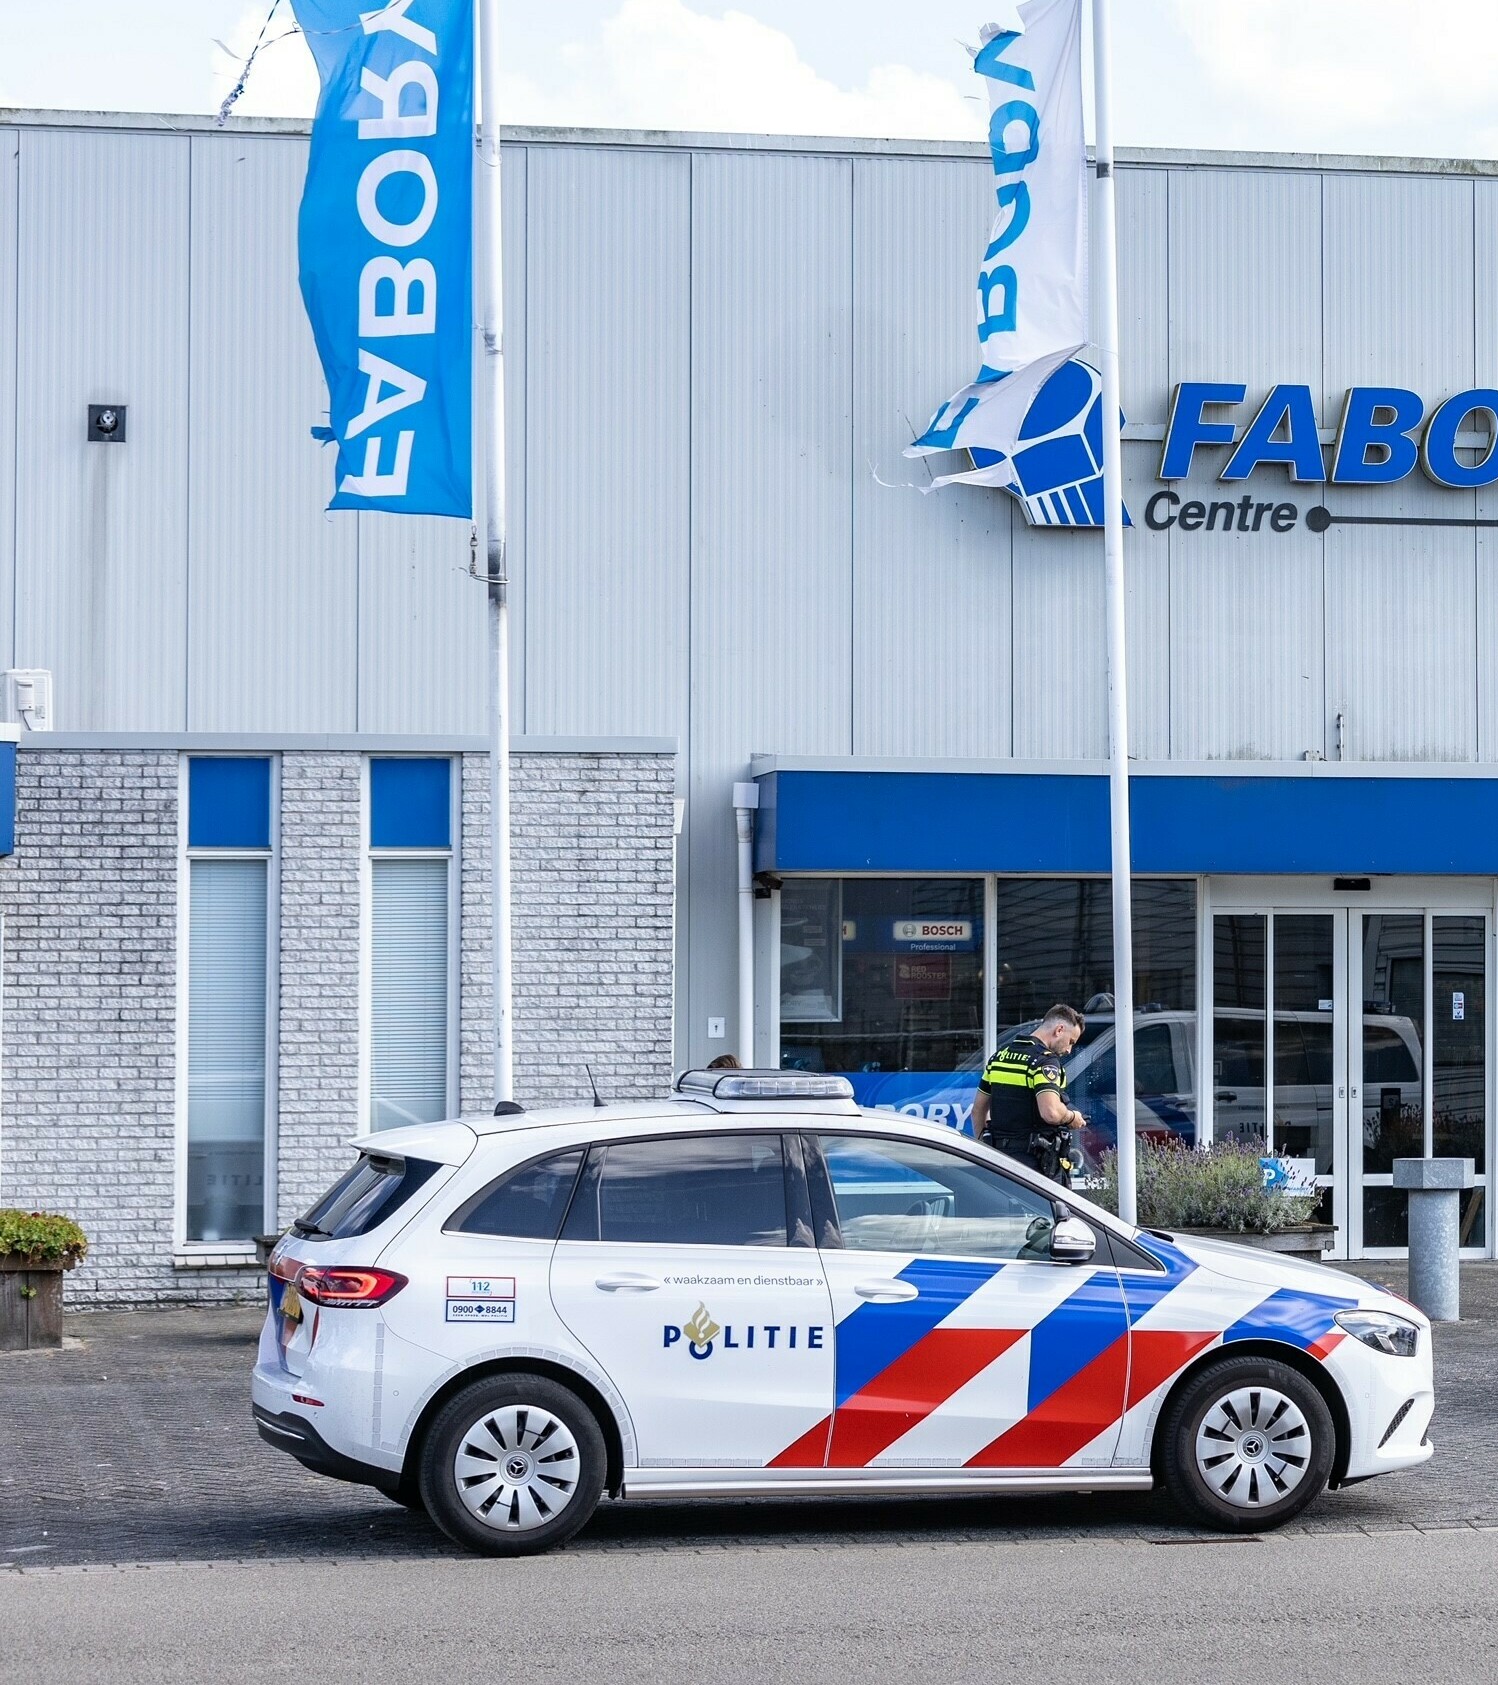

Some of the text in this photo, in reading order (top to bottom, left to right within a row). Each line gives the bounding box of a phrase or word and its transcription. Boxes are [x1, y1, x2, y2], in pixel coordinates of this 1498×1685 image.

[1144, 489, 1298, 533] Centre
[922, 925, 963, 936] BOSCH
[910, 943, 956, 951] Professional
[911, 965, 927, 973] RED
[911, 972, 947, 980] ROOSTER
[674, 1274, 735, 1284] waakzaam
[753, 1276, 814, 1286] dienstbaar
[663, 1325, 824, 1360] POLITIE
